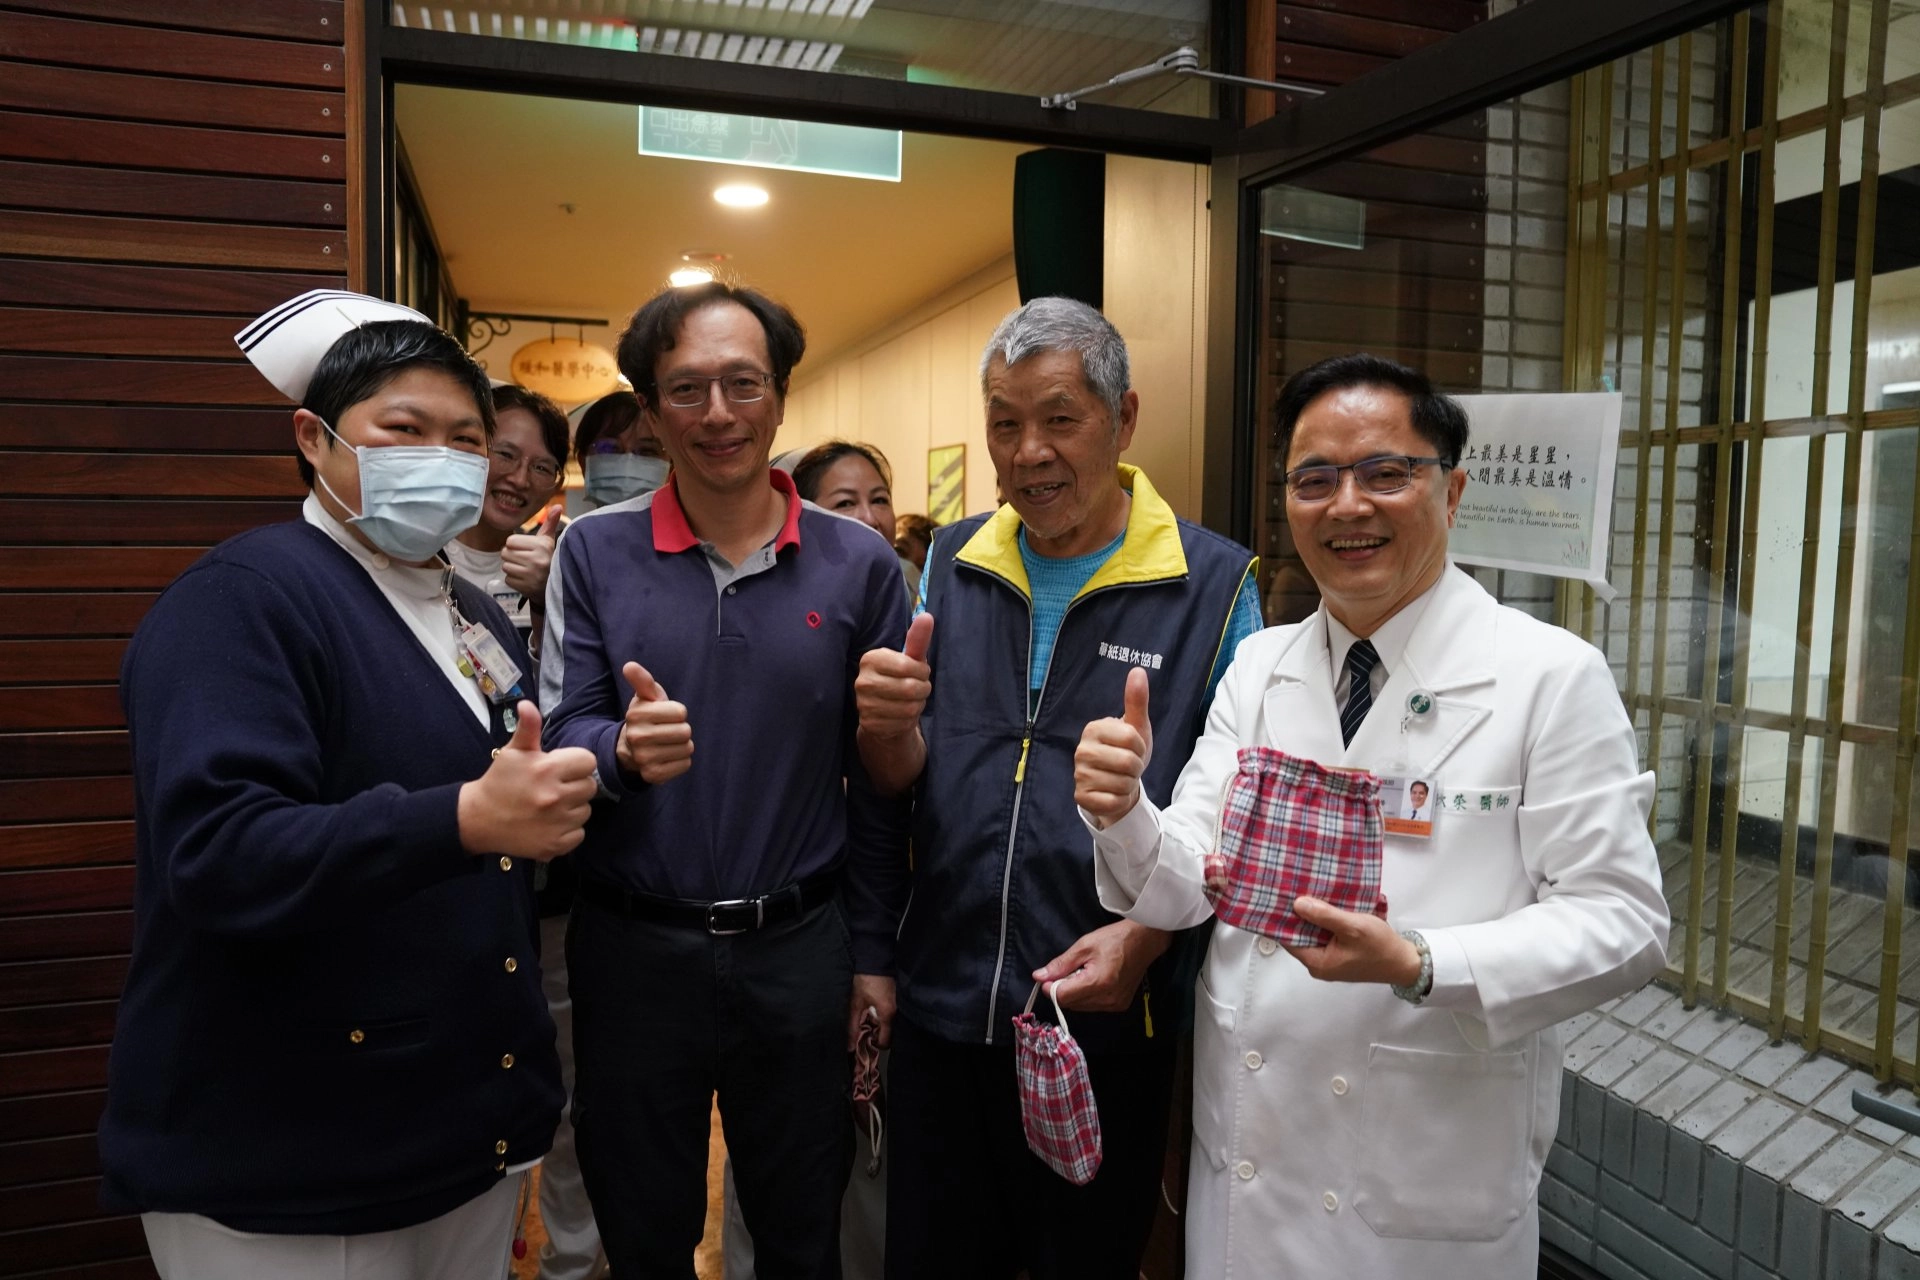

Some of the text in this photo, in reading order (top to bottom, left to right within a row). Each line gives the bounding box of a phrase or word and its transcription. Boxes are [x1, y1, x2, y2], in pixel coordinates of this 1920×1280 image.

[1460, 444, 1570, 464] 上最美是星星，
[1472, 504, 1499, 514] beautiful
[1508, 506, 1519, 515] the
[1549, 509, 1560, 518] the
[1460, 513, 1486, 521] beautiful
[1526, 518, 1549, 527] human
[1551, 521, 1580, 529] warmth
[1480, 793, 1510, 811] 醫師
